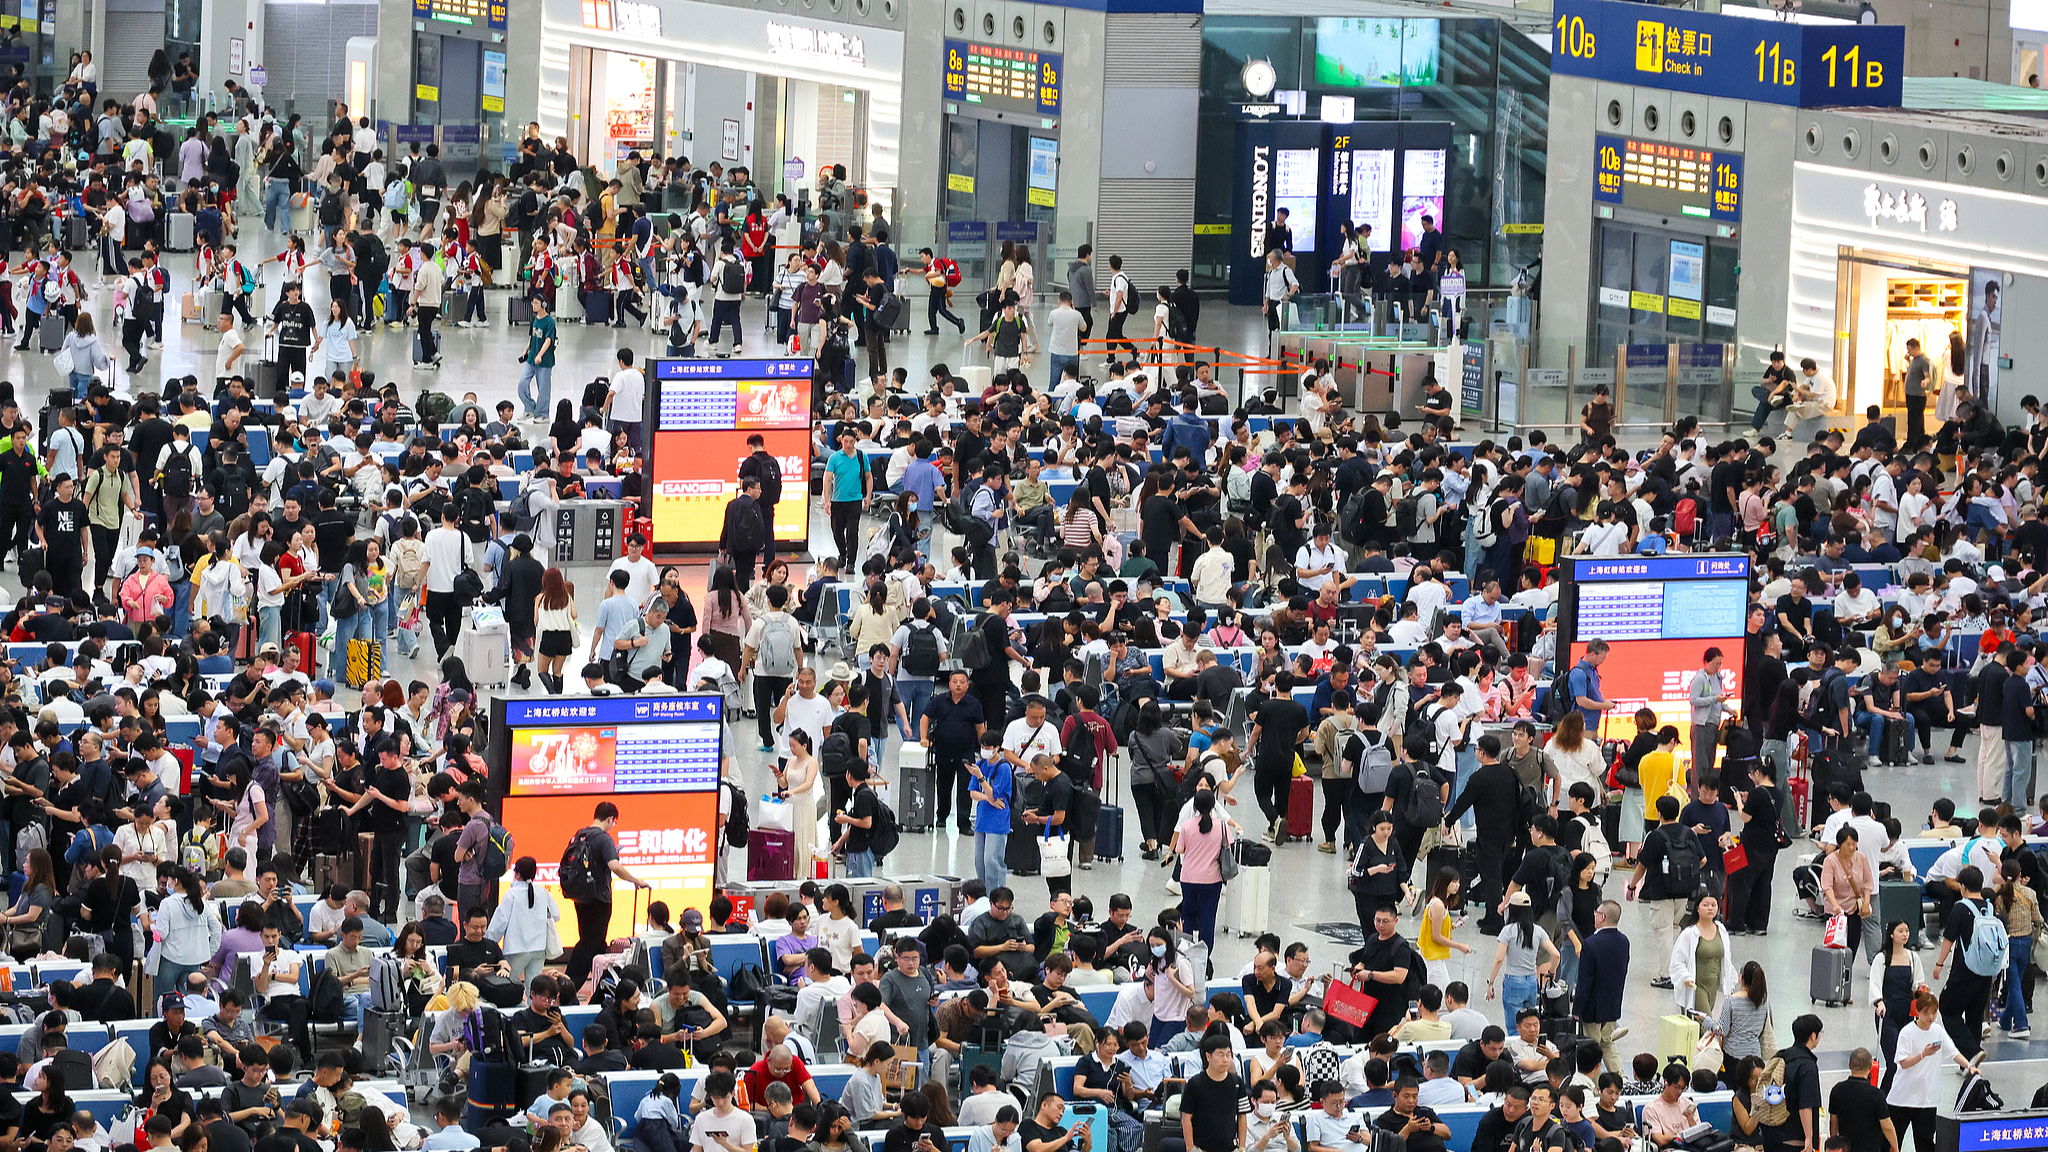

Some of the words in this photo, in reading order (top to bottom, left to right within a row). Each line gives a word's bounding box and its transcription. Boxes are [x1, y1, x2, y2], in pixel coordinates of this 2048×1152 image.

[1557, 14, 1596, 59] 10B
[1666, 26, 1712, 57] 检票口
[949, 49, 962, 70] 8B
[1665, 58, 1691, 75] Check
[1694, 64, 1702, 77] in
[1754, 40, 1795, 86] 11B
[1821, 44, 1884, 88] 11B
[1043, 63, 1057, 84] 9B
[1242, 105, 1280, 114] LONGINES
[1334, 136, 1350, 148] 2F
[1600, 146, 1621, 171] 10B
[1599, 172, 1620, 187] 检票口
[1716, 163, 1738, 189] 11B
[1601, 185, 1613, 193] Check
[1715, 190, 1737, 205] 检票口
[1250, 146, 1269, 258] LONGINES
[1717, 203, 1729, 211] Check
[1588, 565, 1647, 574] 上海虹桥站欢迎您
[524, 706, 597, 718] 上海虹桥站欢迎您
[637, 706, 648, 714] VIP
[653, 701, 699, 712] 商务座候车室
[618, 828, 707, 854] 三和精化
[1980, 1126, 2048, 1142] 上海虹桥站欢
